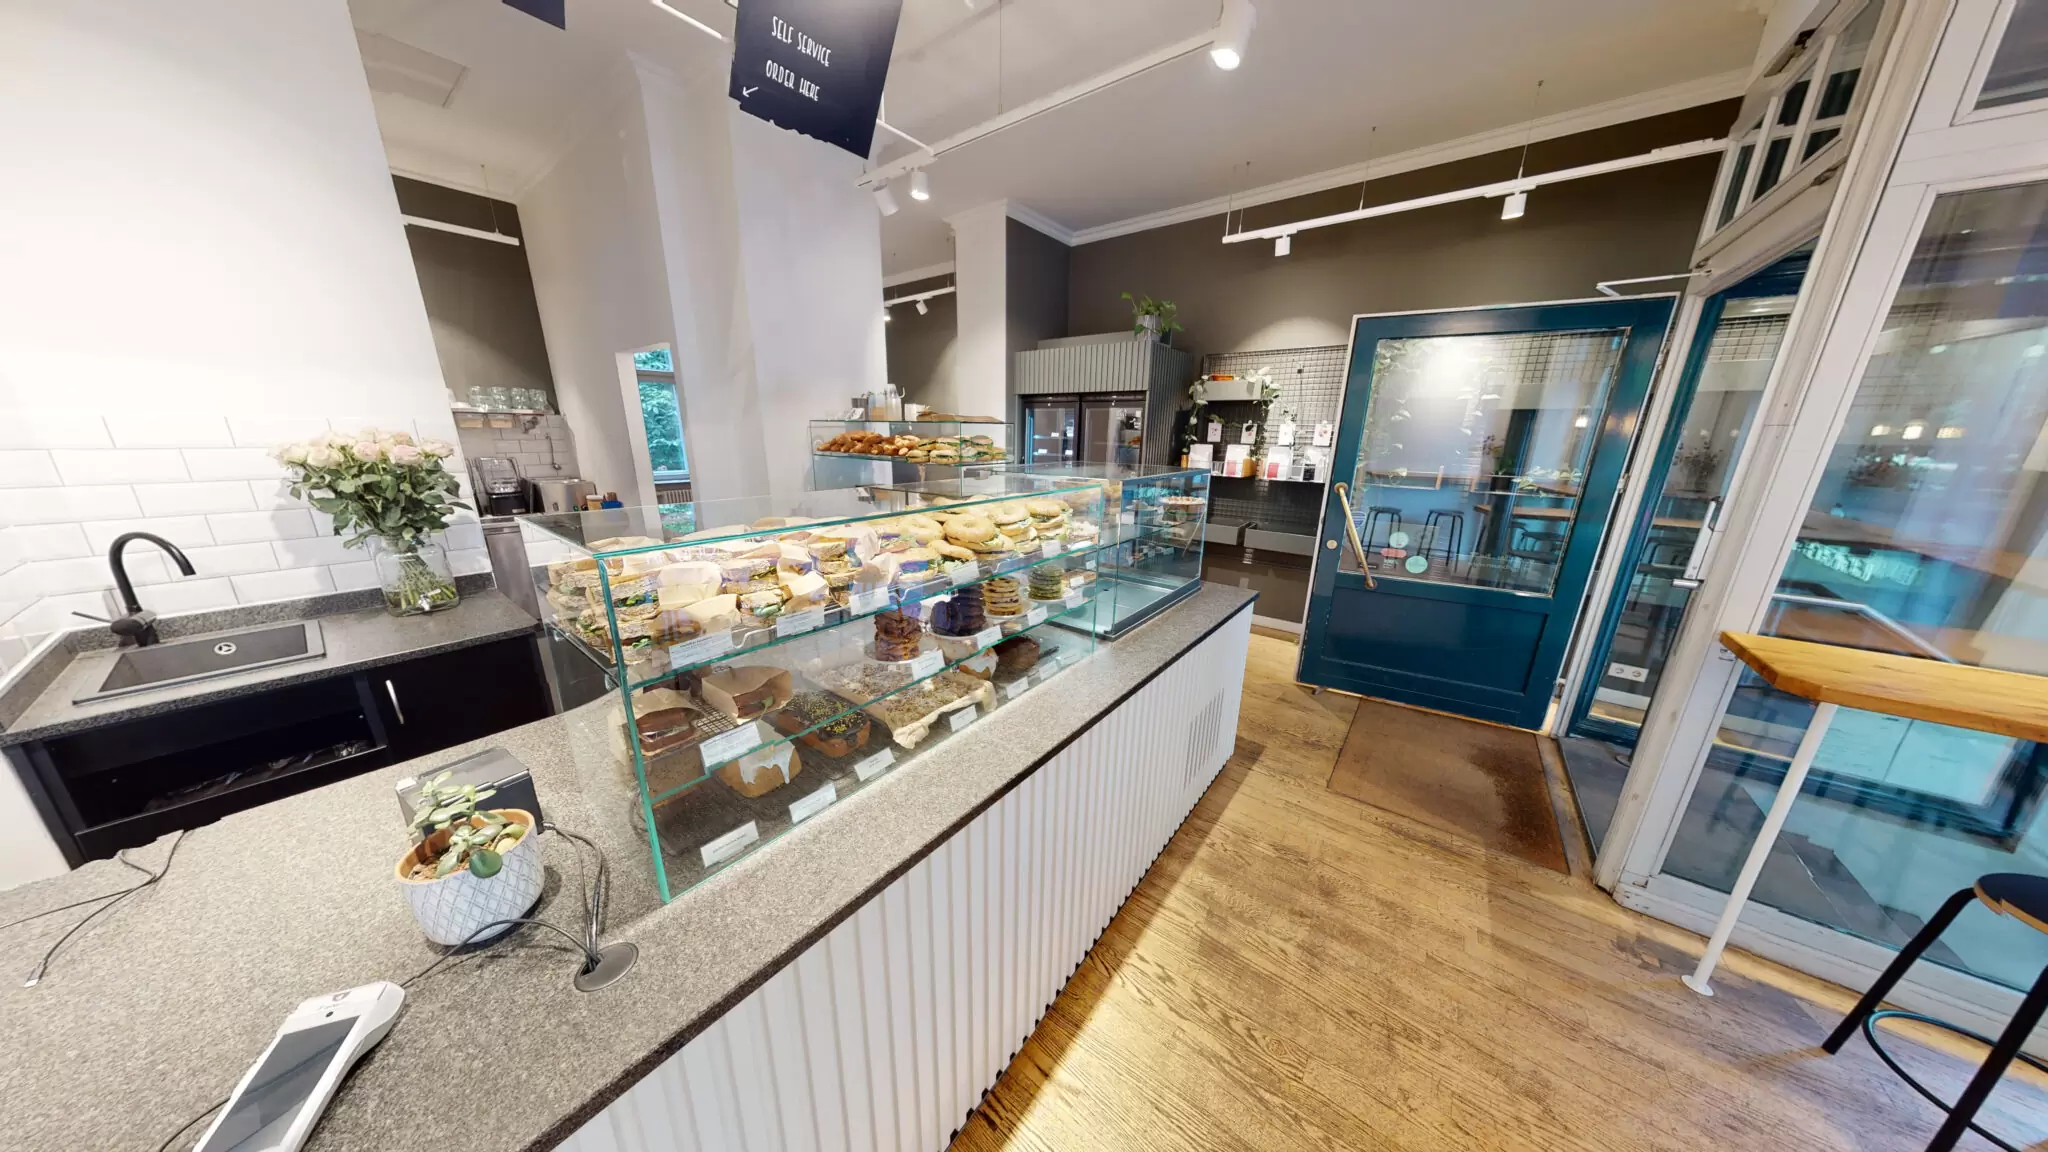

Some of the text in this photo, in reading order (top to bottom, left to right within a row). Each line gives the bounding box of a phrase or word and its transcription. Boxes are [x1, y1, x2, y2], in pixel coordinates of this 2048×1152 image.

[772, 16, 831, 67] SELF SERVICE
[766, 60, 820, 101] ORDER HERE
